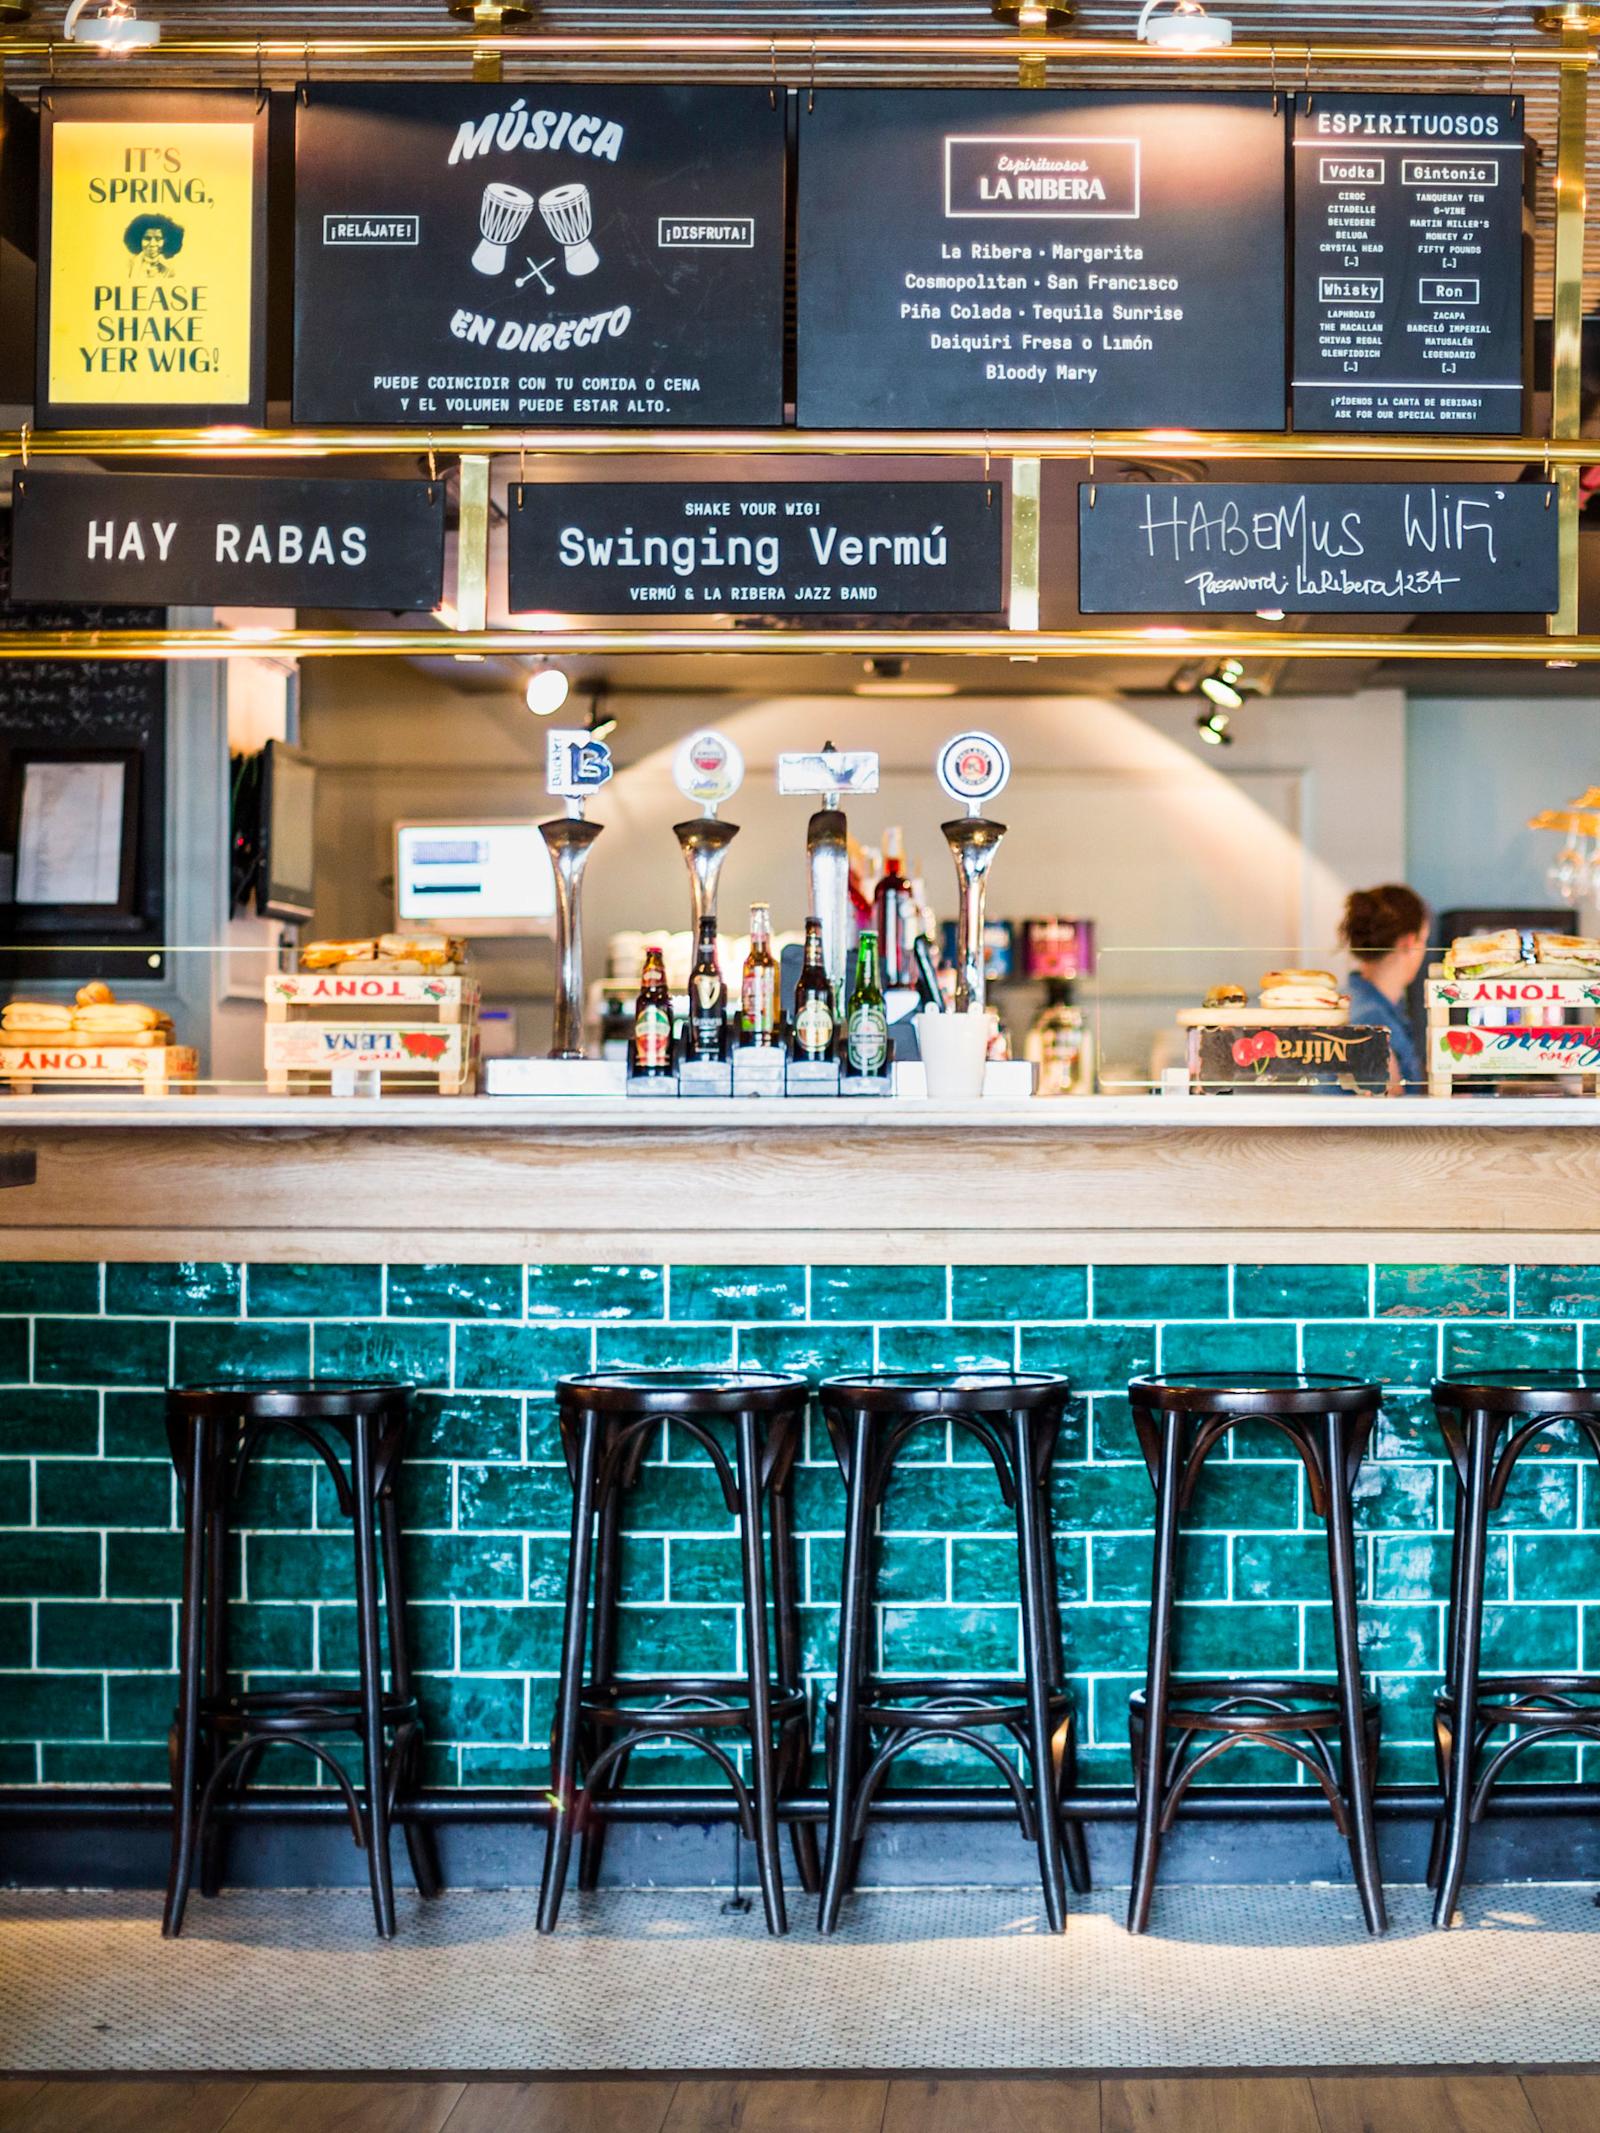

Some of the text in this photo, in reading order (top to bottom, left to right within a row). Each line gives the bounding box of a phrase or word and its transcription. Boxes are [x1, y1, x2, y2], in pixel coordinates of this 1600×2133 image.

[448, 99, 623, 164] MÚSICA
[1318, 114, 1499, 135] ESPIRITUOSOS
[124, 148, 181, 172] IT'S
[998, 157, 1088, 175] Espirituosos
[1330, 165, 1374, 178] Vodka
[1414, 166, 1485, 180] Gintonic
[89, 178, 215, 208] SPRING,
[980, 178, 1106, 200] LA RIBERA
[1339, 192, 1365, 200] CIROC
[1416, 193, 1484, 202] TANQUERAY TEN
[1328, 205, 1375, 213] CITADELLE
[1434, 207, 1465, 215] G-VINE
[1328, 218, 1375, 226] BELVEDERE
[1410, 219, 1489, 228] MARTIN MILLER'S
[332, 222, 411, 240] ¡RELÁJATE!
[666, 226, 746, 242] ¡DISFRUTA!
[1336, 231, 1367, 239] BELUGA
[942, 244, 1143, 263] La Ribera Margarita
[1320, 244, 1357, 252] CRYSTAL
[1418, 245, 1481, 254] FIFTY POUNDS
[1048, 274, 1078, 289] San
[94, 286, 207, 311] PLEASE
[1324, 283, 1379, 299] Whisky
[1437, 285, 1462, 297] Ron
[901, 304, 1183, 322] Piña Colada Tequila Sunrise
[1328, 310, 1375, 318] LAPHROAIG
[97, 317, 203, 342] SHAKE
[450, 305, 631, 352] EN DIRECTO
[1320, 323, 1383, 331] THE MACALLAN
[1407, 323, 1491, 333] BARCELÓ IMPERIAL
[931, 334, 1012, 352] Daiquiri
[1022, 334, 1072, 349] Fresa
[1082, 338, 1092, 350] o
[1319, 336, 1351, 344] CHIVAS
[1425, 337, 1473, 346] MATUSALÉN
[80, 348, 219, 372] YER WIG!
[1322, 349, 1380, 357] GLENFIDDICH
[1423, 351, 1475, 359] LEGENDARIO
[986, 364, 1097, 383] Bloody Mary
[374, 376, 700, 391] PUEDE COINCIDIR CON TU COMIDA O CENA
[401, 398, 670, 412] Y EL VOLUMEN PUEDE ESTAR ALTO.
[1331, 396, 1372, 406] ¡PÍDENOS
[1425, 398, 1435, 406] DE
[1335, 410, 1351, 418] ASK
[1357, 410, 1372, 418] FOR
[1398, 411, 1435, 419] SPECIAL
[685, 503, 819, 515] SHAKE YOUR WIG!
[88, 521, 366, 565] HAY RABAS
[559, 526, 946, 576] Swinging Vermú
[630, 585, 877, 600] VERMÚ & LA RIBERA JAZZ BAND
[313, 980, 405, 997] TONY
[1473, 984, 1565, 1000] TONY
[323, 1034, 393, 1050] LENA
[1276, 1040, 1347, 1064] Mifra
[18, 1053, 108, 1069] TONY
